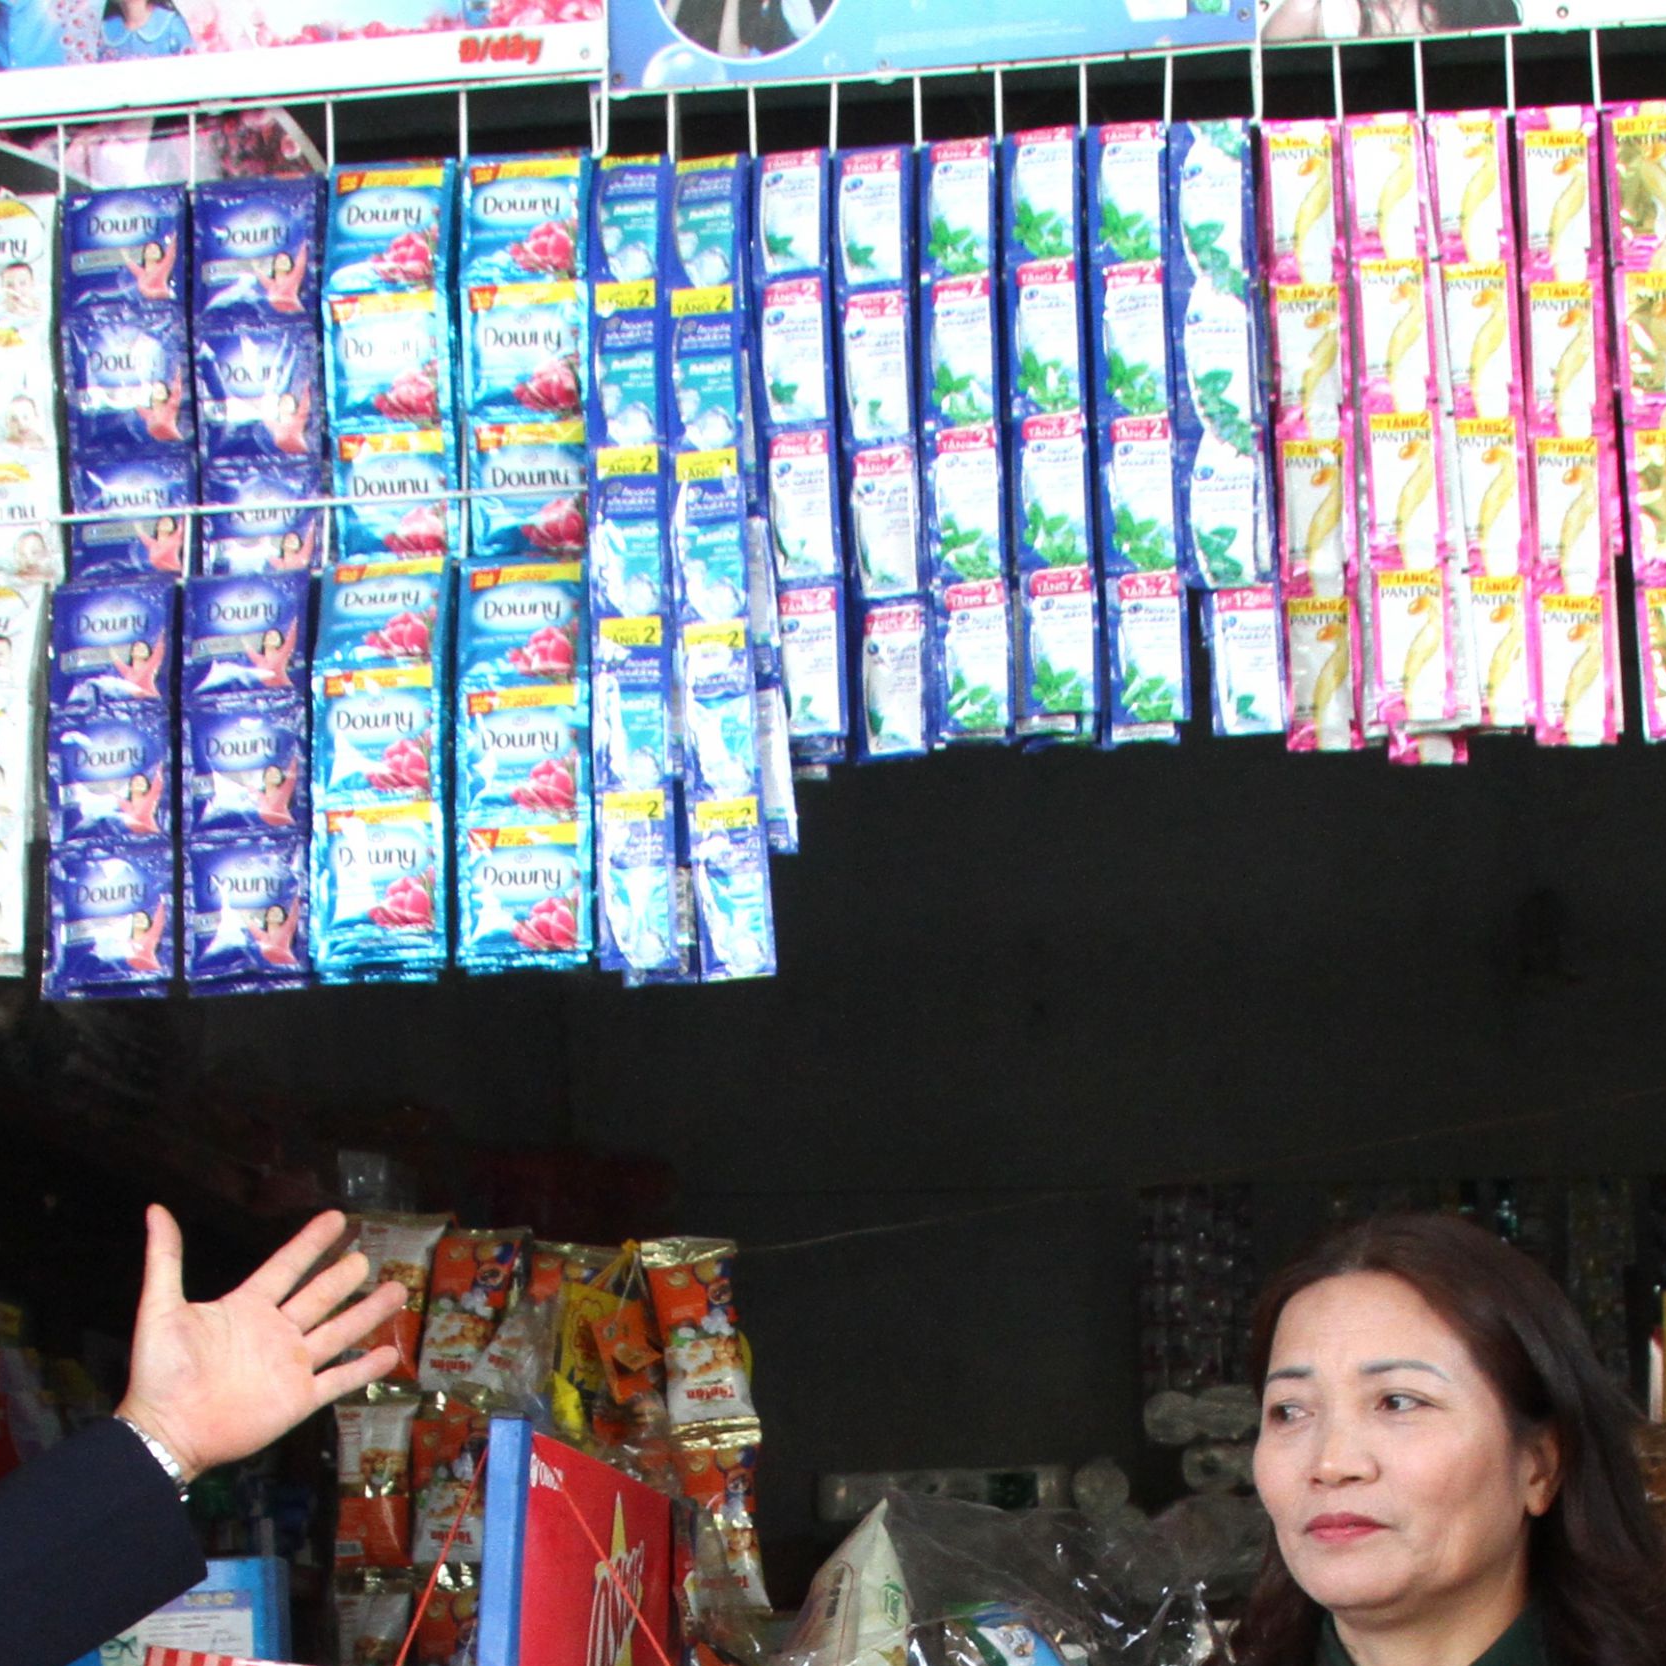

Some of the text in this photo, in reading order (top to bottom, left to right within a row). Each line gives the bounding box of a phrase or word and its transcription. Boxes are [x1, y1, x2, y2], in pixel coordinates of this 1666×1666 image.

[883, 153, 898, 170] 2
[1271, 147, 1330, 161] PANTENE
[1526, 147, 1584, 159] PANTENE
[345, 203, 422, 227] Downy
[85, 214, 161, 238] Downy
[1057, 264, 1070, 281] 2
[1532, 300, 1592, 312] PANTENE
[483, 324, 562, 351] Downy
[1150, 420, 1164, 438] 2
[1372, 429, 1431, 443] PANTENE
[1070, 572, 1085, 591] 2
[1158, 576, 1173, 594] 2
[206, 599, 282, 624] Downy
[482, 597, 562, 622] Downy
[76, 612, 150, 638] Downy
[1290, 613, 1348, 625] PANTENE
[335, 708, 415, 733] Downy
[483, 864, 563, 890] Downy
